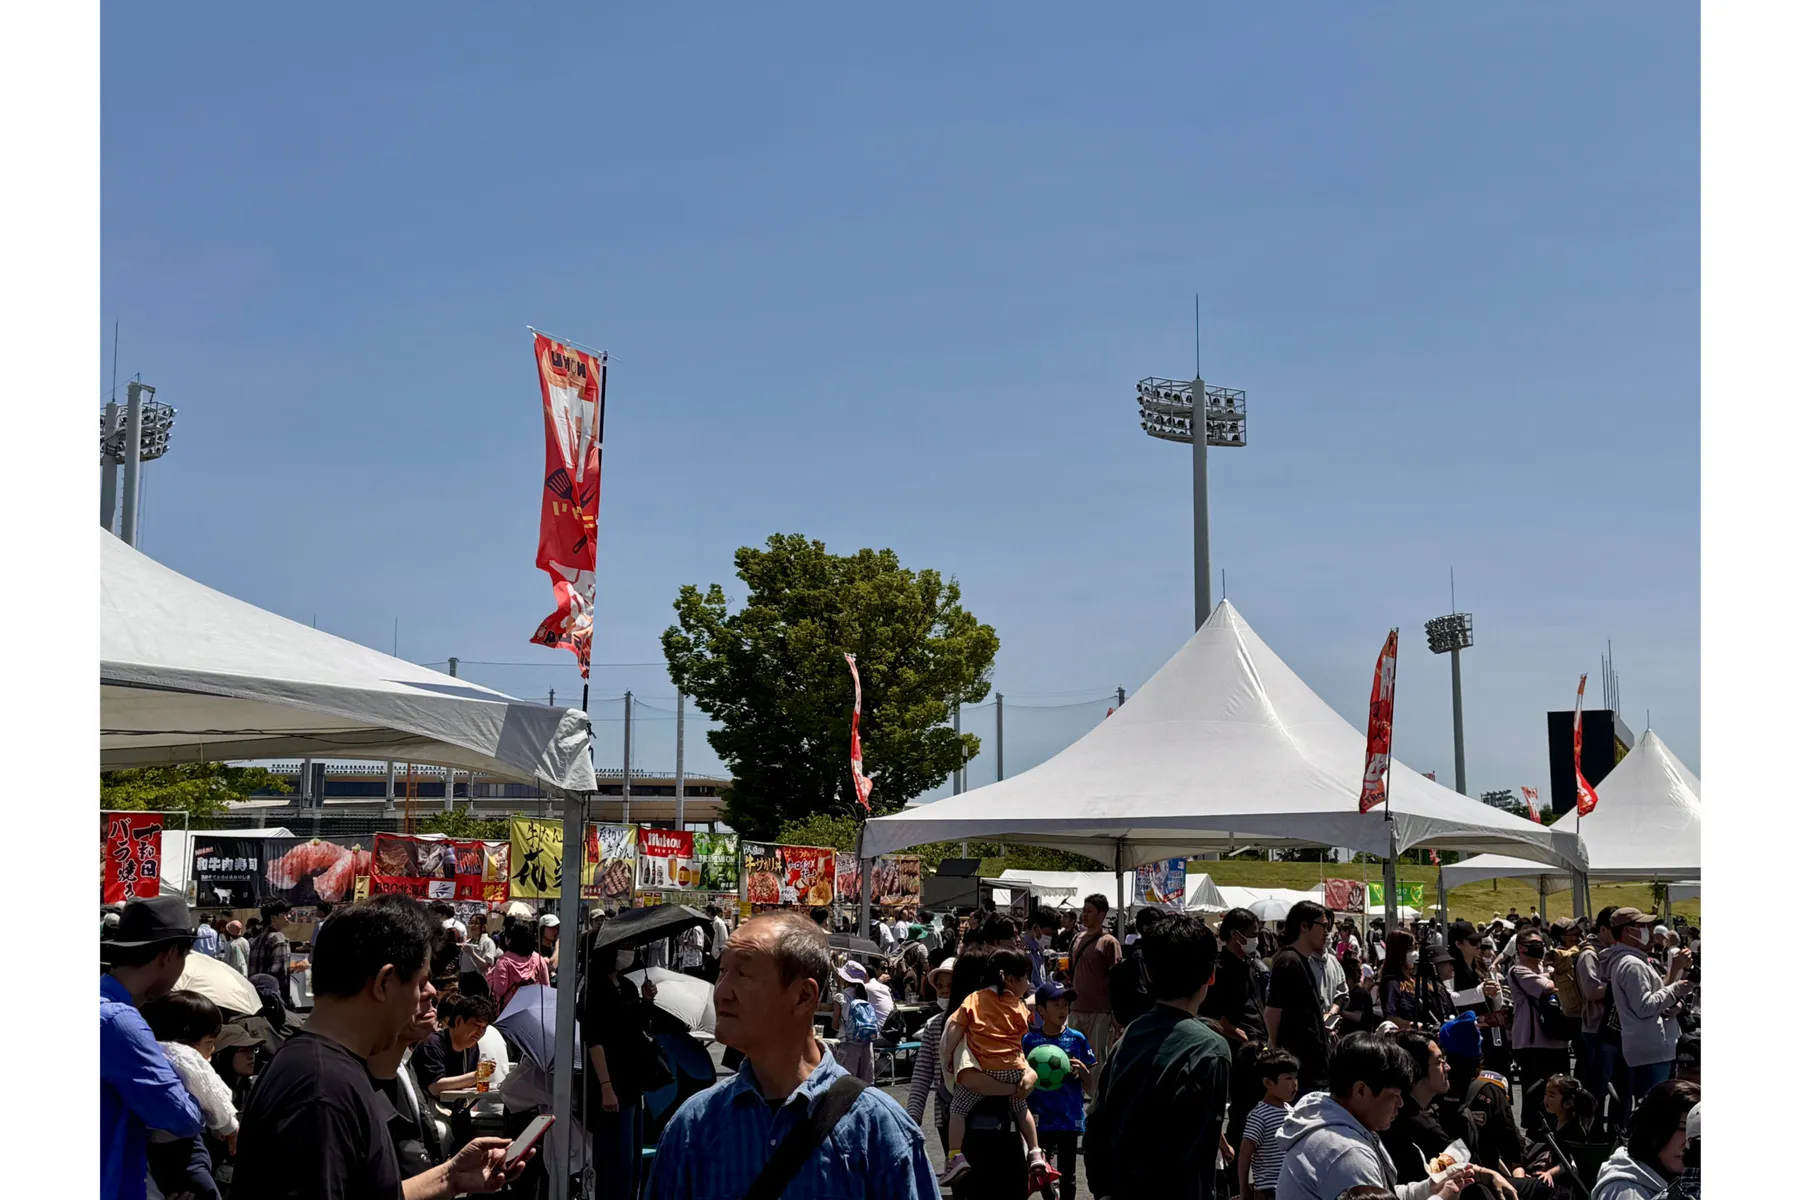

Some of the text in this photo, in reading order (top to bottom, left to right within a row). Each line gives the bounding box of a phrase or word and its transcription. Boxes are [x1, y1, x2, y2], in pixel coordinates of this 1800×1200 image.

[108, 818, 138, 898] バラ焼き
[132, 823, 162, 879] 十和田
[196, 856, 258, 872] 和牛肉寿司
